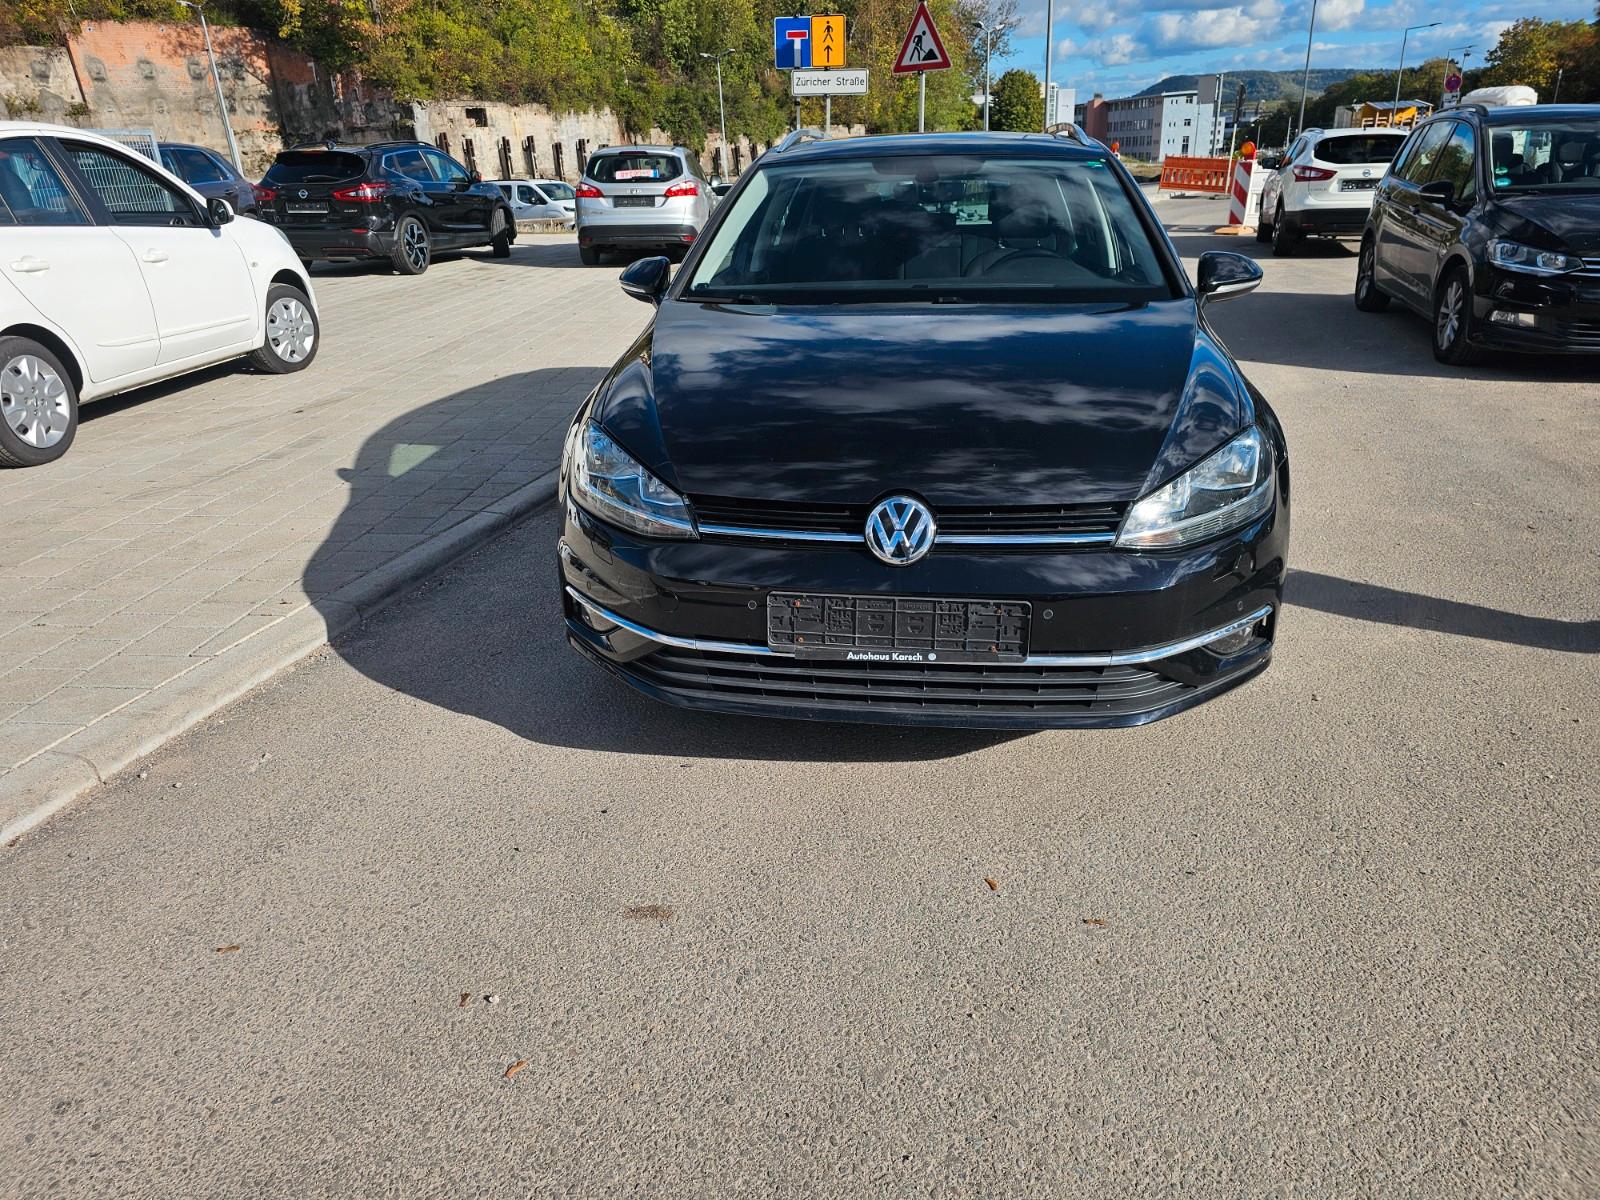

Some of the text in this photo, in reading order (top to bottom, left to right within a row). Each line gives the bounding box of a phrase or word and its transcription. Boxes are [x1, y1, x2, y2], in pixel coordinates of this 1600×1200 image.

[795, 76, 865, 86] Züricher Straße
[846, 651, 923, 661] Autohaus Karsch
